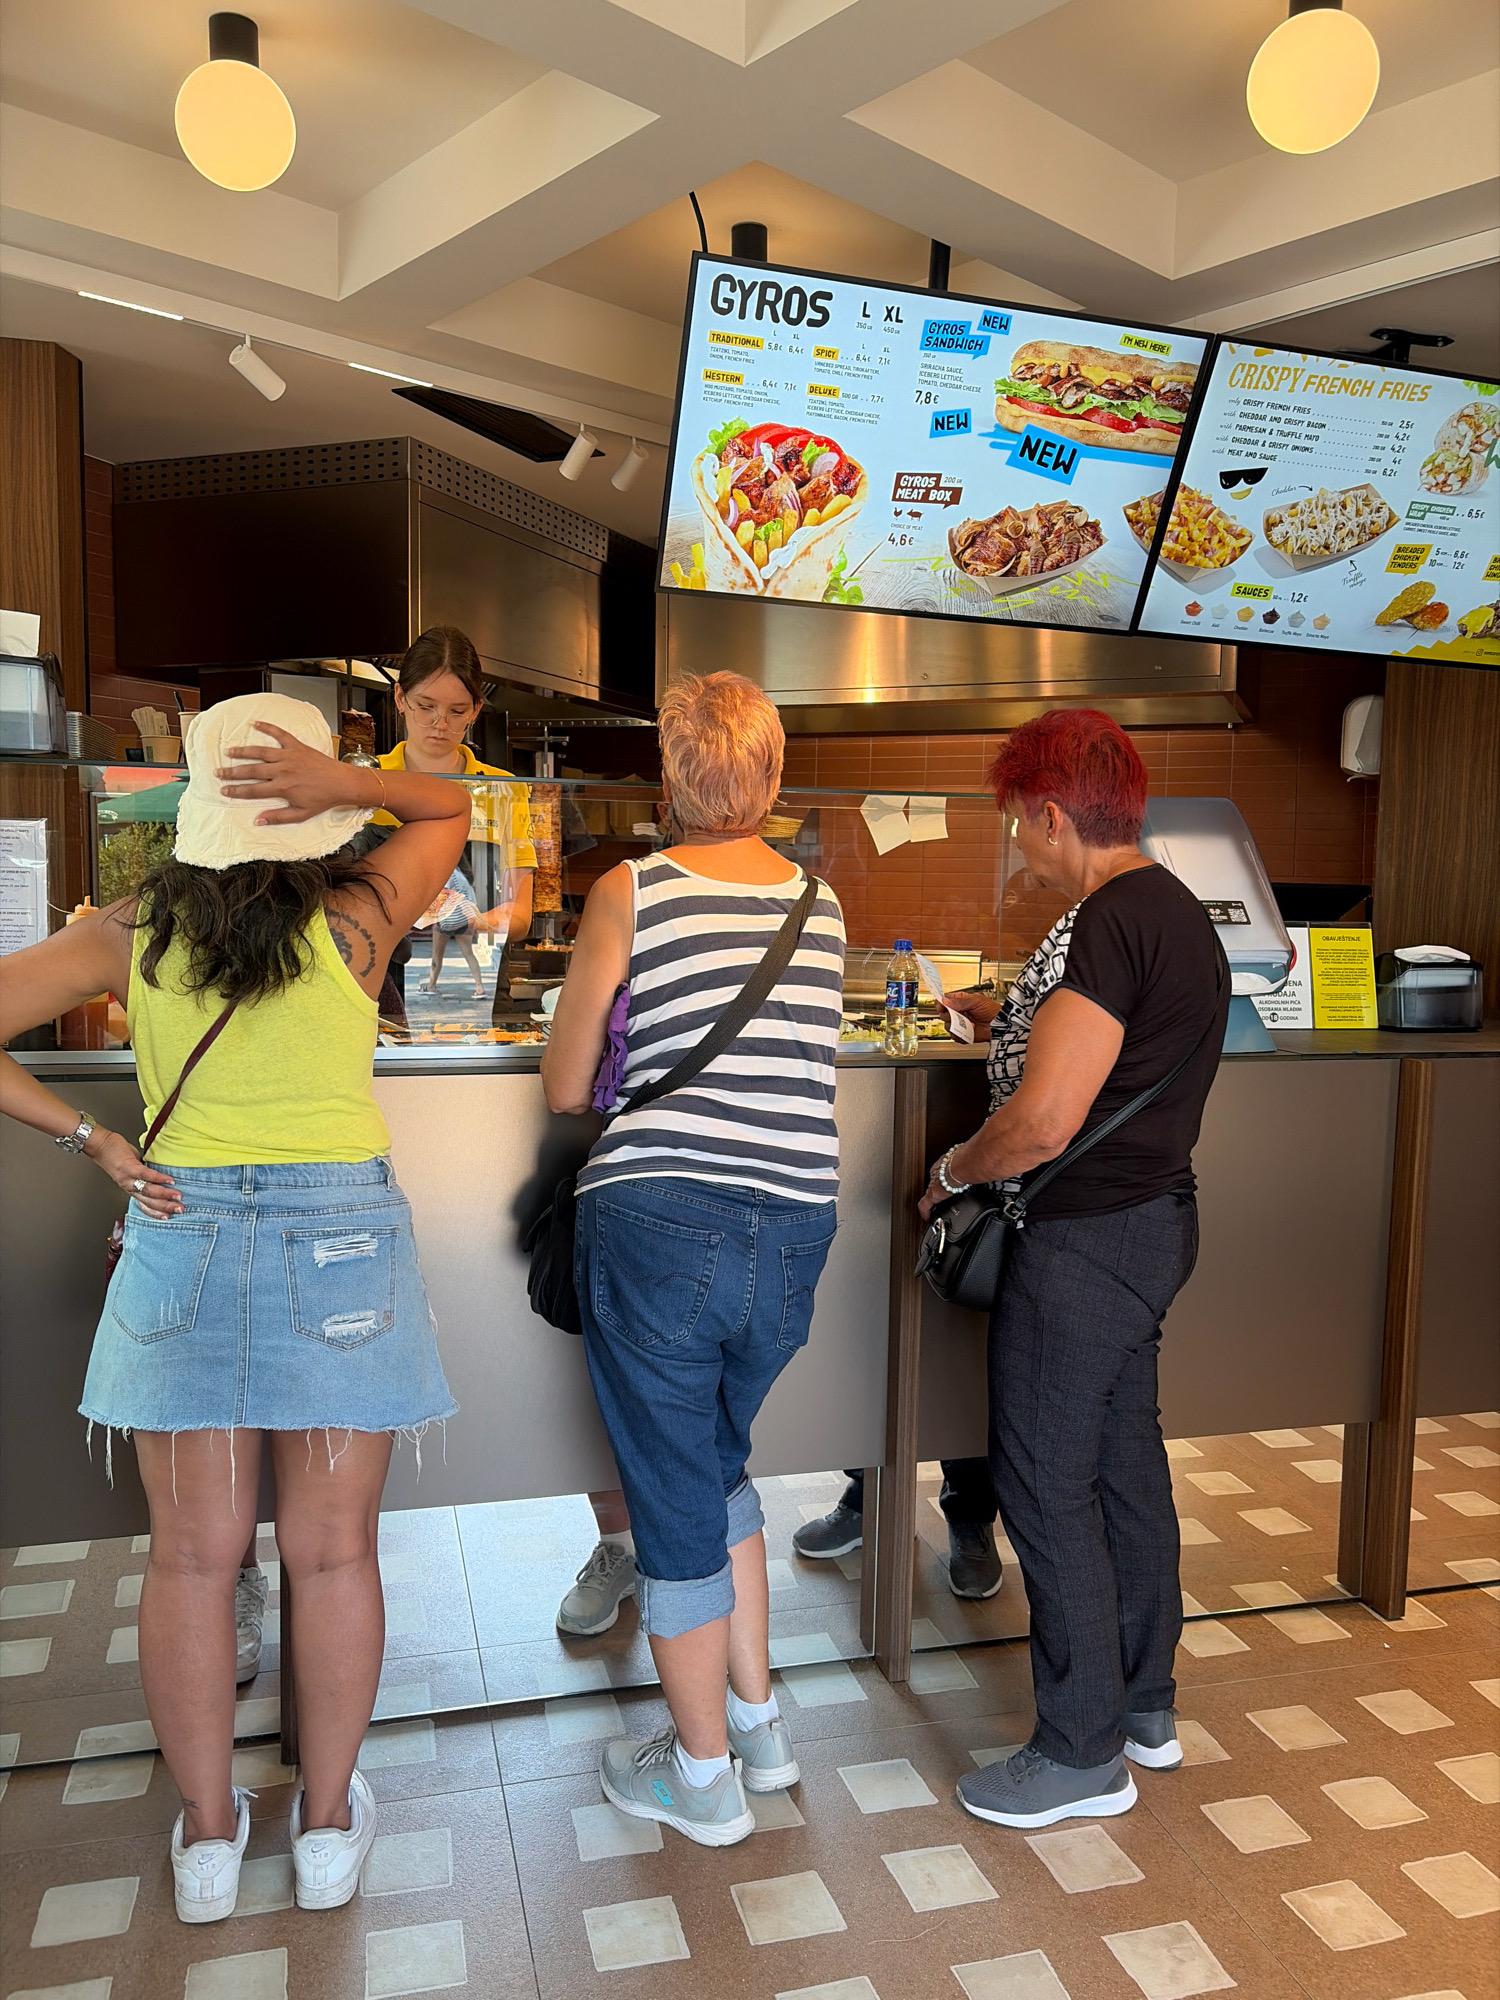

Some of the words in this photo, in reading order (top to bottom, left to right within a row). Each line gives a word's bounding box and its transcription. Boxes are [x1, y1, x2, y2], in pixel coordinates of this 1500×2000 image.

[711, 273, 833, 328] GYROS
[861, 301, 871, 318] L
[883, 305, 904, 324] XL
[856, 322, 867, 330] 350
[883, 326, 894, 334] 450
[928, 322, 966, 336] GYROS
[983, 314, 1010, 331] NEW
[711, 333, 761, 348] TRADITIONAL
[767, 342, 783, 351] 5,8€
[788, 345, 805, 354] 6,4€
[924, 336, 984, 351] SANDWICH
[1123, 336, 1133, 346] I'M
[1134, 339, 1148, 349] NEW
[1149, 342, 1170, 355] HERE!
[743, 357, 755, 365] FRIES
[815, 348, 836, 359] SPICY
[855, 353, 871, 362] 6,4€
[878, 357, 891, 366] 7,1€
[919, 370, 940, 378] ICEBERG
[940, 374, 963, 382] LETTUCE,
[920, 363, 945, 372] SRIRACHA
[946, 366, 963, 374] SAUCE,
[705, 371, 741, 383] WESTERN
[762, 379, 778, 389] 6,4€
[784, 382, 797, 392] 7,1€
[918, 378, 938, 387] TOMATO,
[939, 381, 962, 390] CHEDDAR
[962, 385, 982, 393] CHEESE
[1228, 362, 1306, 394] CRISPY
[1302, 375, 1375, 398] FRENCH
[1377, 381, 1432, 402] FRIES
[724, 398, 741, 406] FRENCH
[809, 386, 837, 397] DELUXE
[871, 395, 884, 403] 7,7€
[915, 390, 939, 405] 7,8€
[1228, 397, 1241, 406] only
[1243, 398, 1265, 408] CRISPY
[1266, 402, 1291, 412] FRENCH
[1292, 405, 1312, 415] FRIES
[1399, 420, 1415, 429] 2,5€
[934, 412, 968, 431] NEW
[1239, 411, 1267, 422] CHEDDAR
[1269, 416, 1282, 424] AND
[1284, 417, 1306, 427] CRISPY
[1306, 420, 1327, 430] BACON
[1394, 432, 1411, 441] 4,2€
[1234, 423, 1267, 434] PARMESAN
[1268, 428, 1273, 436] &
[1276, 429, 1302, 440] TRUFFLE
[1304, 434, 1320, 442] MAYO
[1390, 444, 1406, 453] 4,2€
[1018, 434, 1077, 475] NEW
[1231, 436, 1259, 446] CHEDDAR
[1268, 441, 1290, 451] CRISPY
[1291, 444, 1314, 454] ONIONS
[1392, 457, 1402, 465] 4€
[1227, 449, 1243, 457] MEAT
[1245, 451, 1257, 459] AND
[1258, 453, 1278, 462] SAUCE
[1382, 468, 1398, 477] 6,2€
[899, 474, 937, 488] GYROS
[944, 476, 956, 484] 200
[895, 487, 927, 501] MEAT
[929, 489, 952, 501] BOX
[1271, 485, 1296, 496] Cheddar
[1467, 508, 1485, 520] 6,5€
[888, 533, 914, 546] 4,6€
[1396, 546, 1425, 554] BREADED
[1435, 548, 1441, 556] 5
[1453, 550, 1470, 559] 6,6€
[1389, 561, 1418, 569] TENDERS
[1393, 554, 1421, 562] CHICKEN
[1428, 559, 1437, 567] 10
[1452, 561, 1465, 570] 12€
[1235, 586, 1270, 598] SAUCES
[1290, 591, 1308, 603] 1,2€
[886, 987, 899, 998] RC
